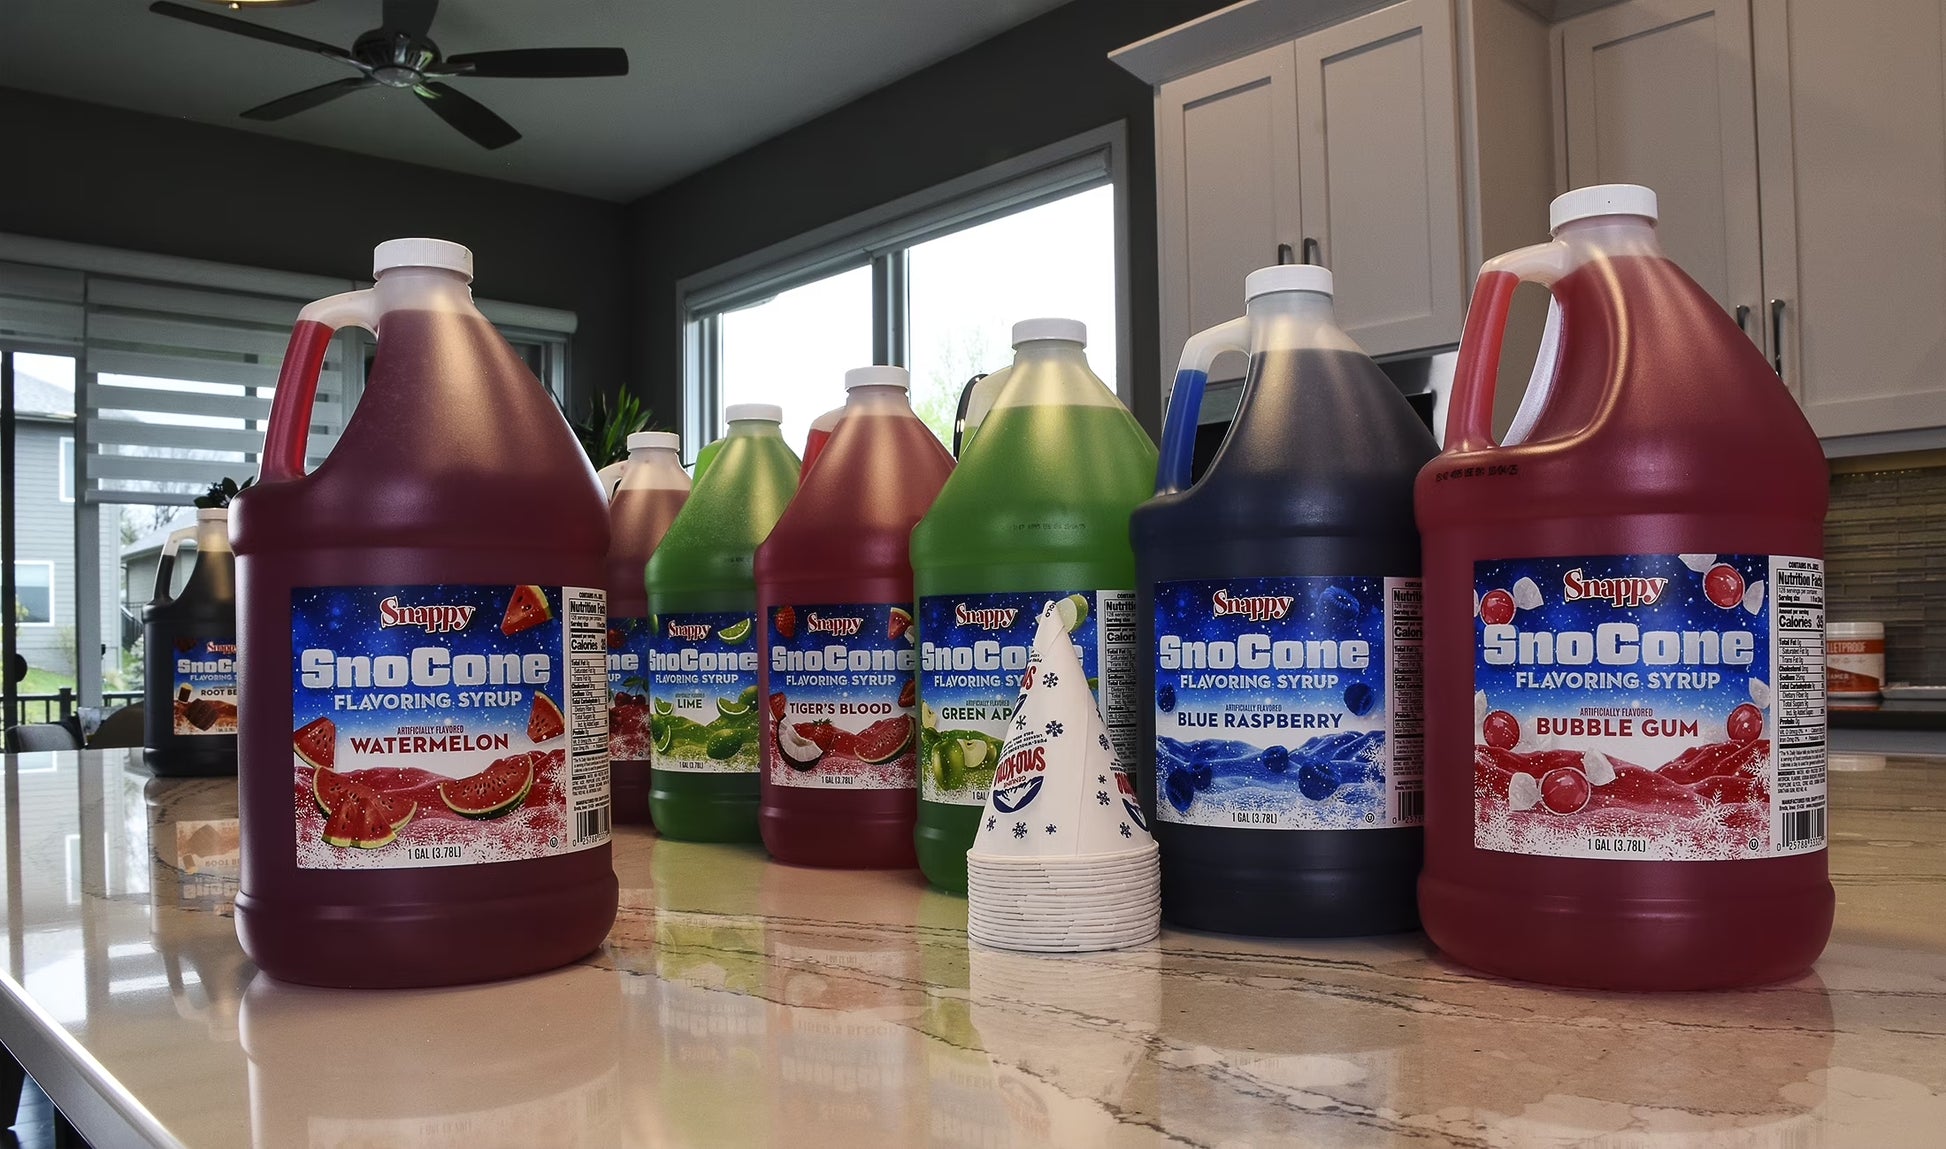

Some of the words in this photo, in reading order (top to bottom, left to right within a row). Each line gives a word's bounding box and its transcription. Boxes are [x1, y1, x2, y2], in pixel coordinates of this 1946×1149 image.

[1778, 571, 1810, 585] Nutrition
[1563, 568, 1668, 607] Snappy
[570, 600, 597, 613] Nutrition
[1213, 589, 1294, 621] Snappy
[379, 596, 475, 633] Snappy
[955, 603, 1018, 630] Snappy
[1778, 614, 1812, 628] Calories
[668, 620, 712, 641] Snappy
[807, 612, 864, 636] Snappy
[571, 638, 598, 651] Calories
[1483, 622, 1754, 666] SnoCone
[772, 645, 916, 672] SnoCone
[1159, 633, 1370, 671] SnoCone
[301, 647, 551, 688] SnoCone
[655, 674, 699, 684] FLAVORING
[701, 674, 739, 684] SYRUP
[786, 675, 849, 686] FLAVORING
[851, 675, 897, 686] SYRUP
[934, 675, 1000, 687] FLAVORING
[1180, 674, 1271, 690] FLAVORING
[1277, 674, 1339, 689] SYRUP
[1516, 672, 1640, 690] FLAVORING
[1648, 672, 1721, 689] SYRUP
[334, 693, 450, 711] FLAVORING
[458, 691, 522, 707] SYRUP
[677, 699, 703, 709] LIME
[1225, 704, 1256, 712] ARTIFICIALLY
[1256, 704, 1283, 712] FLAVORED
[789, 702, 836, 715] TIGER'S
[839, 703, 892, 715] BLOOD
[942, 708, 986, 721] GREEN
[1579, 707, 1620, 717] ARTIFICIALLY
[1621, 707, 1653, 717] FLAVORED
[1178, 712, 1218, 728] BLUE
[1224, 713, 1344, 729] RASPBERRY
[1536, 718, 1633, 737] BUBBLE
[1641, 719, 1699, 737] GUM
[397, 726, 435, 735] ARTIFICIALLY
[435, 725, 464, 734] FLAVORED
[350, 733, 509, 754] WATERMELON
[825, 776, 835, 785] GAL
[1231, 812, 1236, 823] 1
[1237, 812, 1251, 823] GAL
[1251, 812, 1278, 824] (3.78L)
[1587, 839, 1592, 850] 1
[1594, 839, 1612, 851] GAL
[1614, 839, 1646, 852] (3.78L)
[408, 849, 413, 860] 1
[414, 848, 430, 859] GAL
[432, 846, 461, 859] (3.78L)
